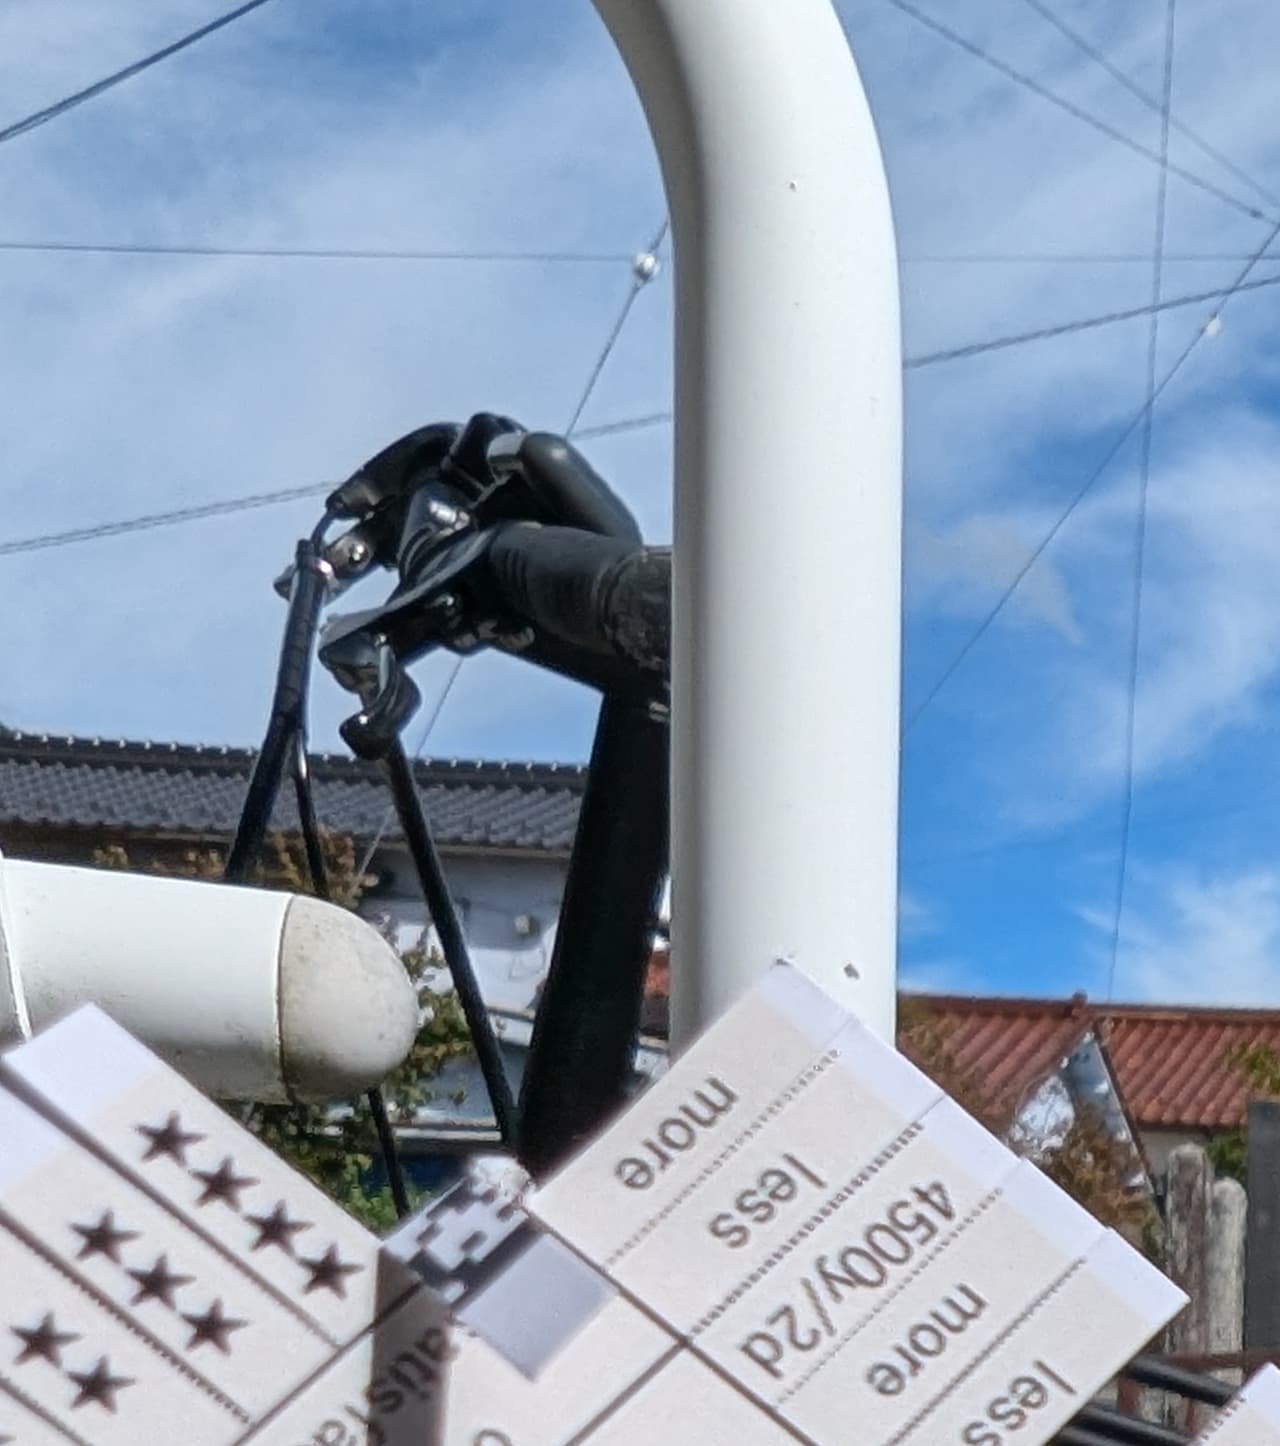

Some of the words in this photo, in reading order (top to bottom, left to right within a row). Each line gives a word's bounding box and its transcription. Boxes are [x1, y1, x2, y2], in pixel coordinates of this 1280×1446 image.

[614, 1077, 741, 1190] more
[709, 1154, 827, 1249] less
[741, 1181, 958, 1379] 4500y/2d
[866, 1283, 990, 1397] more
